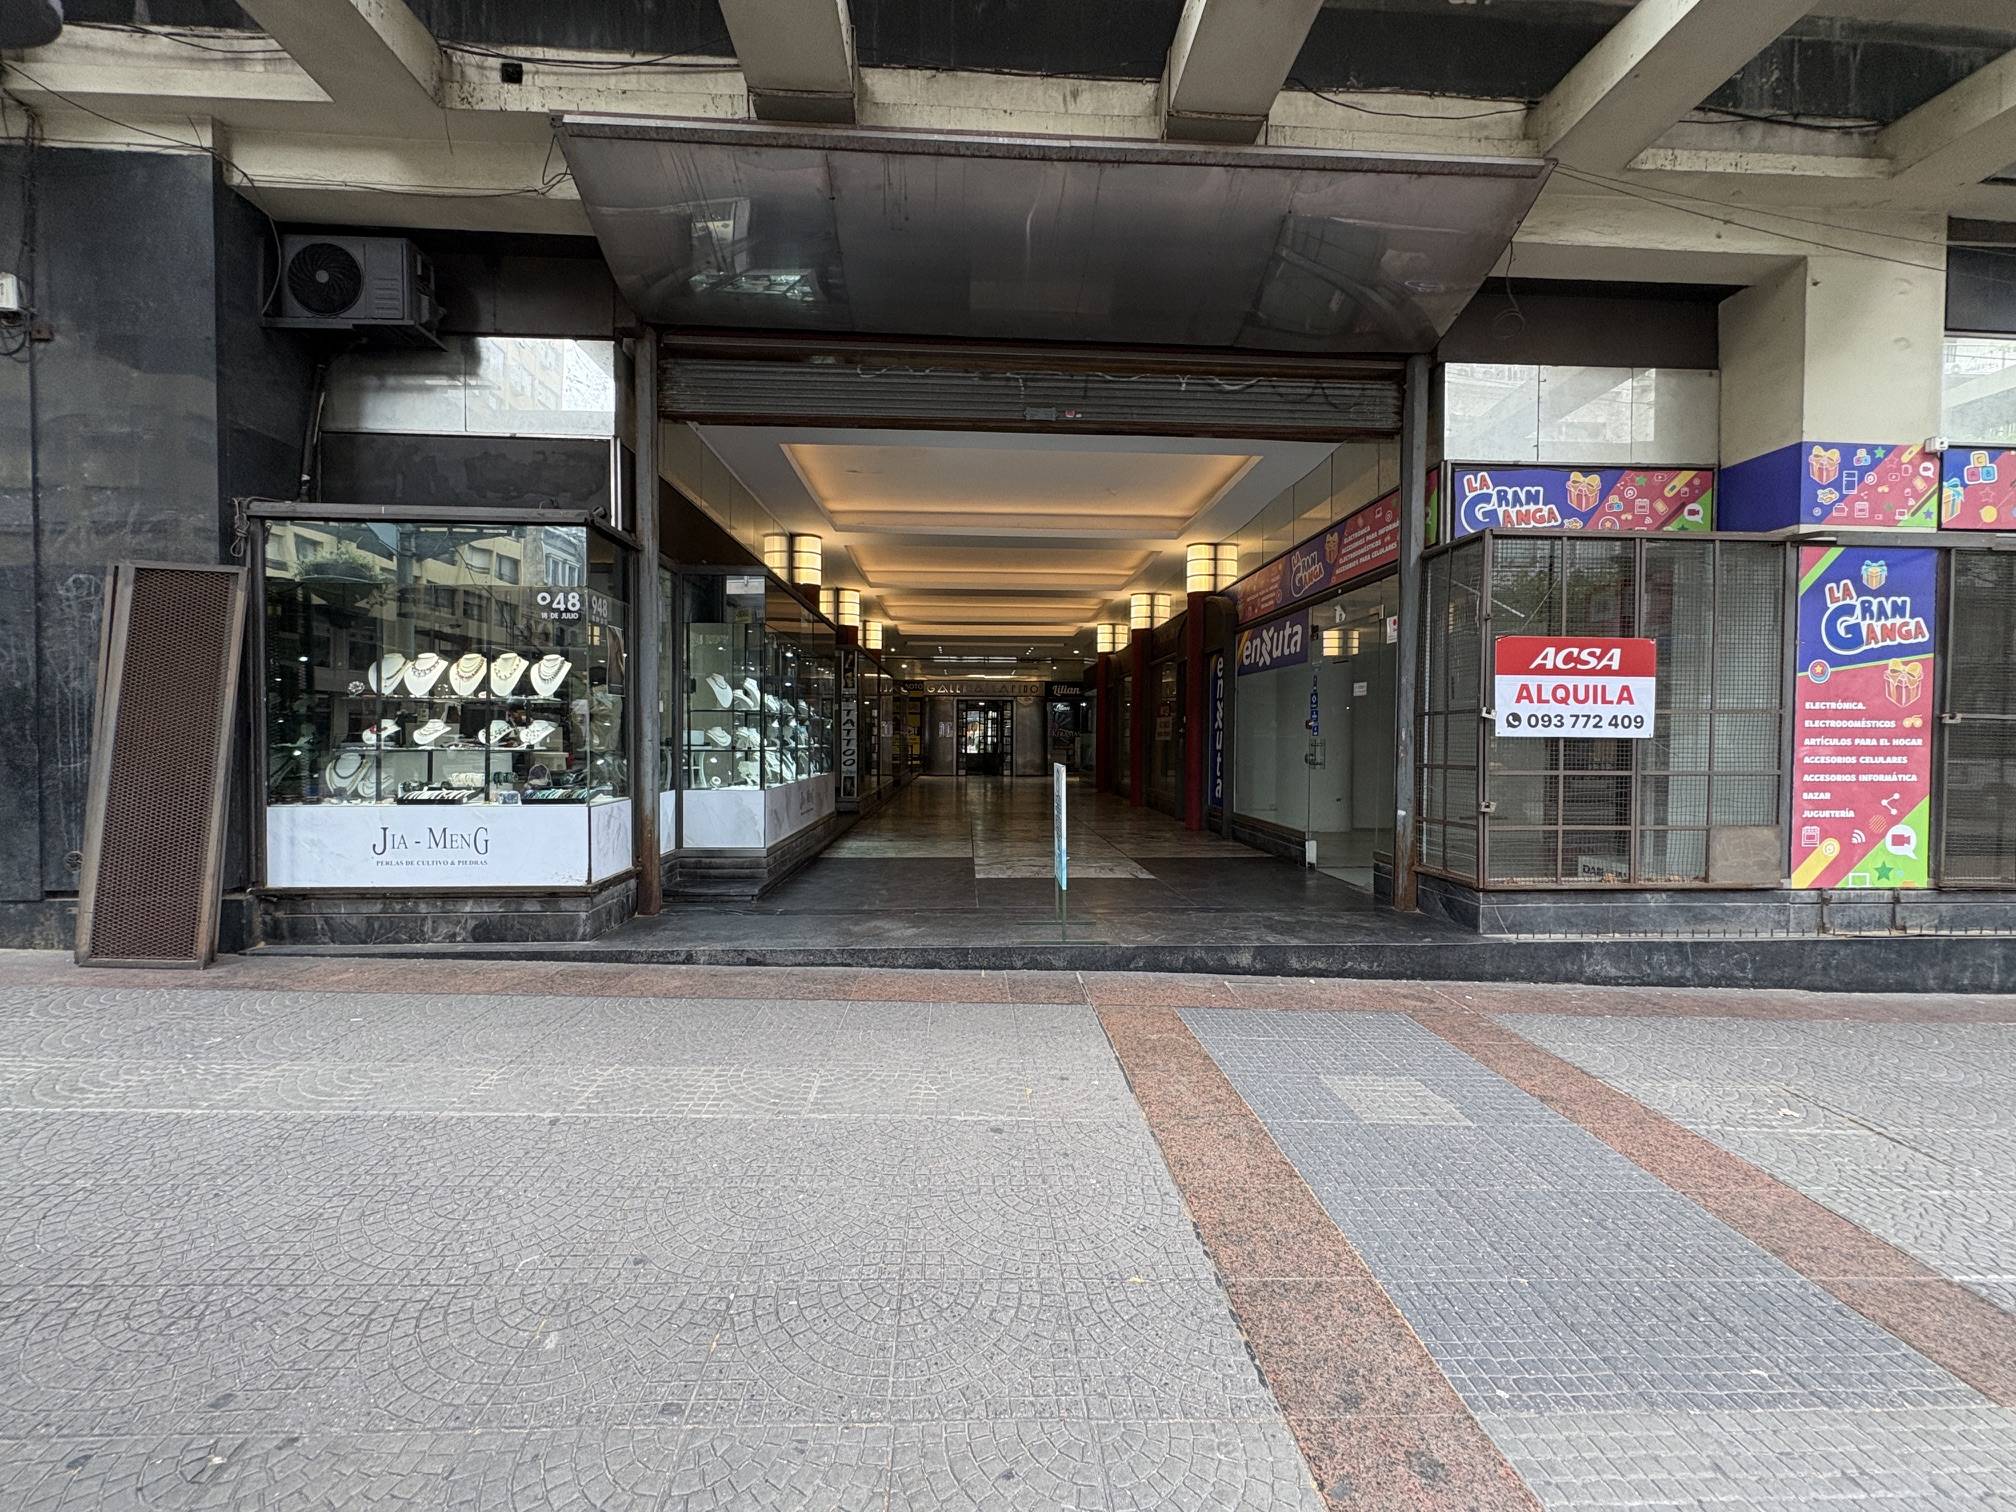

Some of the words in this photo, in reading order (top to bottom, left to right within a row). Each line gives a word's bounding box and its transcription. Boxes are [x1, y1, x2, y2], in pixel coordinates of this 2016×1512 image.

[1464, 473, 1493, 495] LA
[1825, 580, 1857, 607] LA
[1529, 647, 1621, 670] ACSA
[1052, 685, 1080, 696] Lilian
[1515, 683, 1635, 706] ALQUILA
[1527, 713, 1565, 729] 093
[1569, 714, 1603, 729] 772
[1608, 714, 1645, 730] 409
[1804, 718, 1896, 728] ELECTRODOMÉSTICOS
[843, 708, 855, 766] TATTOO
[1804, 736, 1852, 746] ARTÍCULOS
[1854, 738, 1877, 746] PARA
[1880, 738, 1890, 746] EL
[1892, 738, 1923, 746] HOGAR
[1803, 756, 1857, 764] ACCESORIOS
[1859, 756, 1908, 764] CELULARES
[1803, 774, 1856, 782] ACCESORIOS
[1859, 772, 1918, 782] INFORMÁTICA
[1802, 792, 1831, 800] BAZAR
[1802, 808, 1855, 818] JUGUETERÍA
